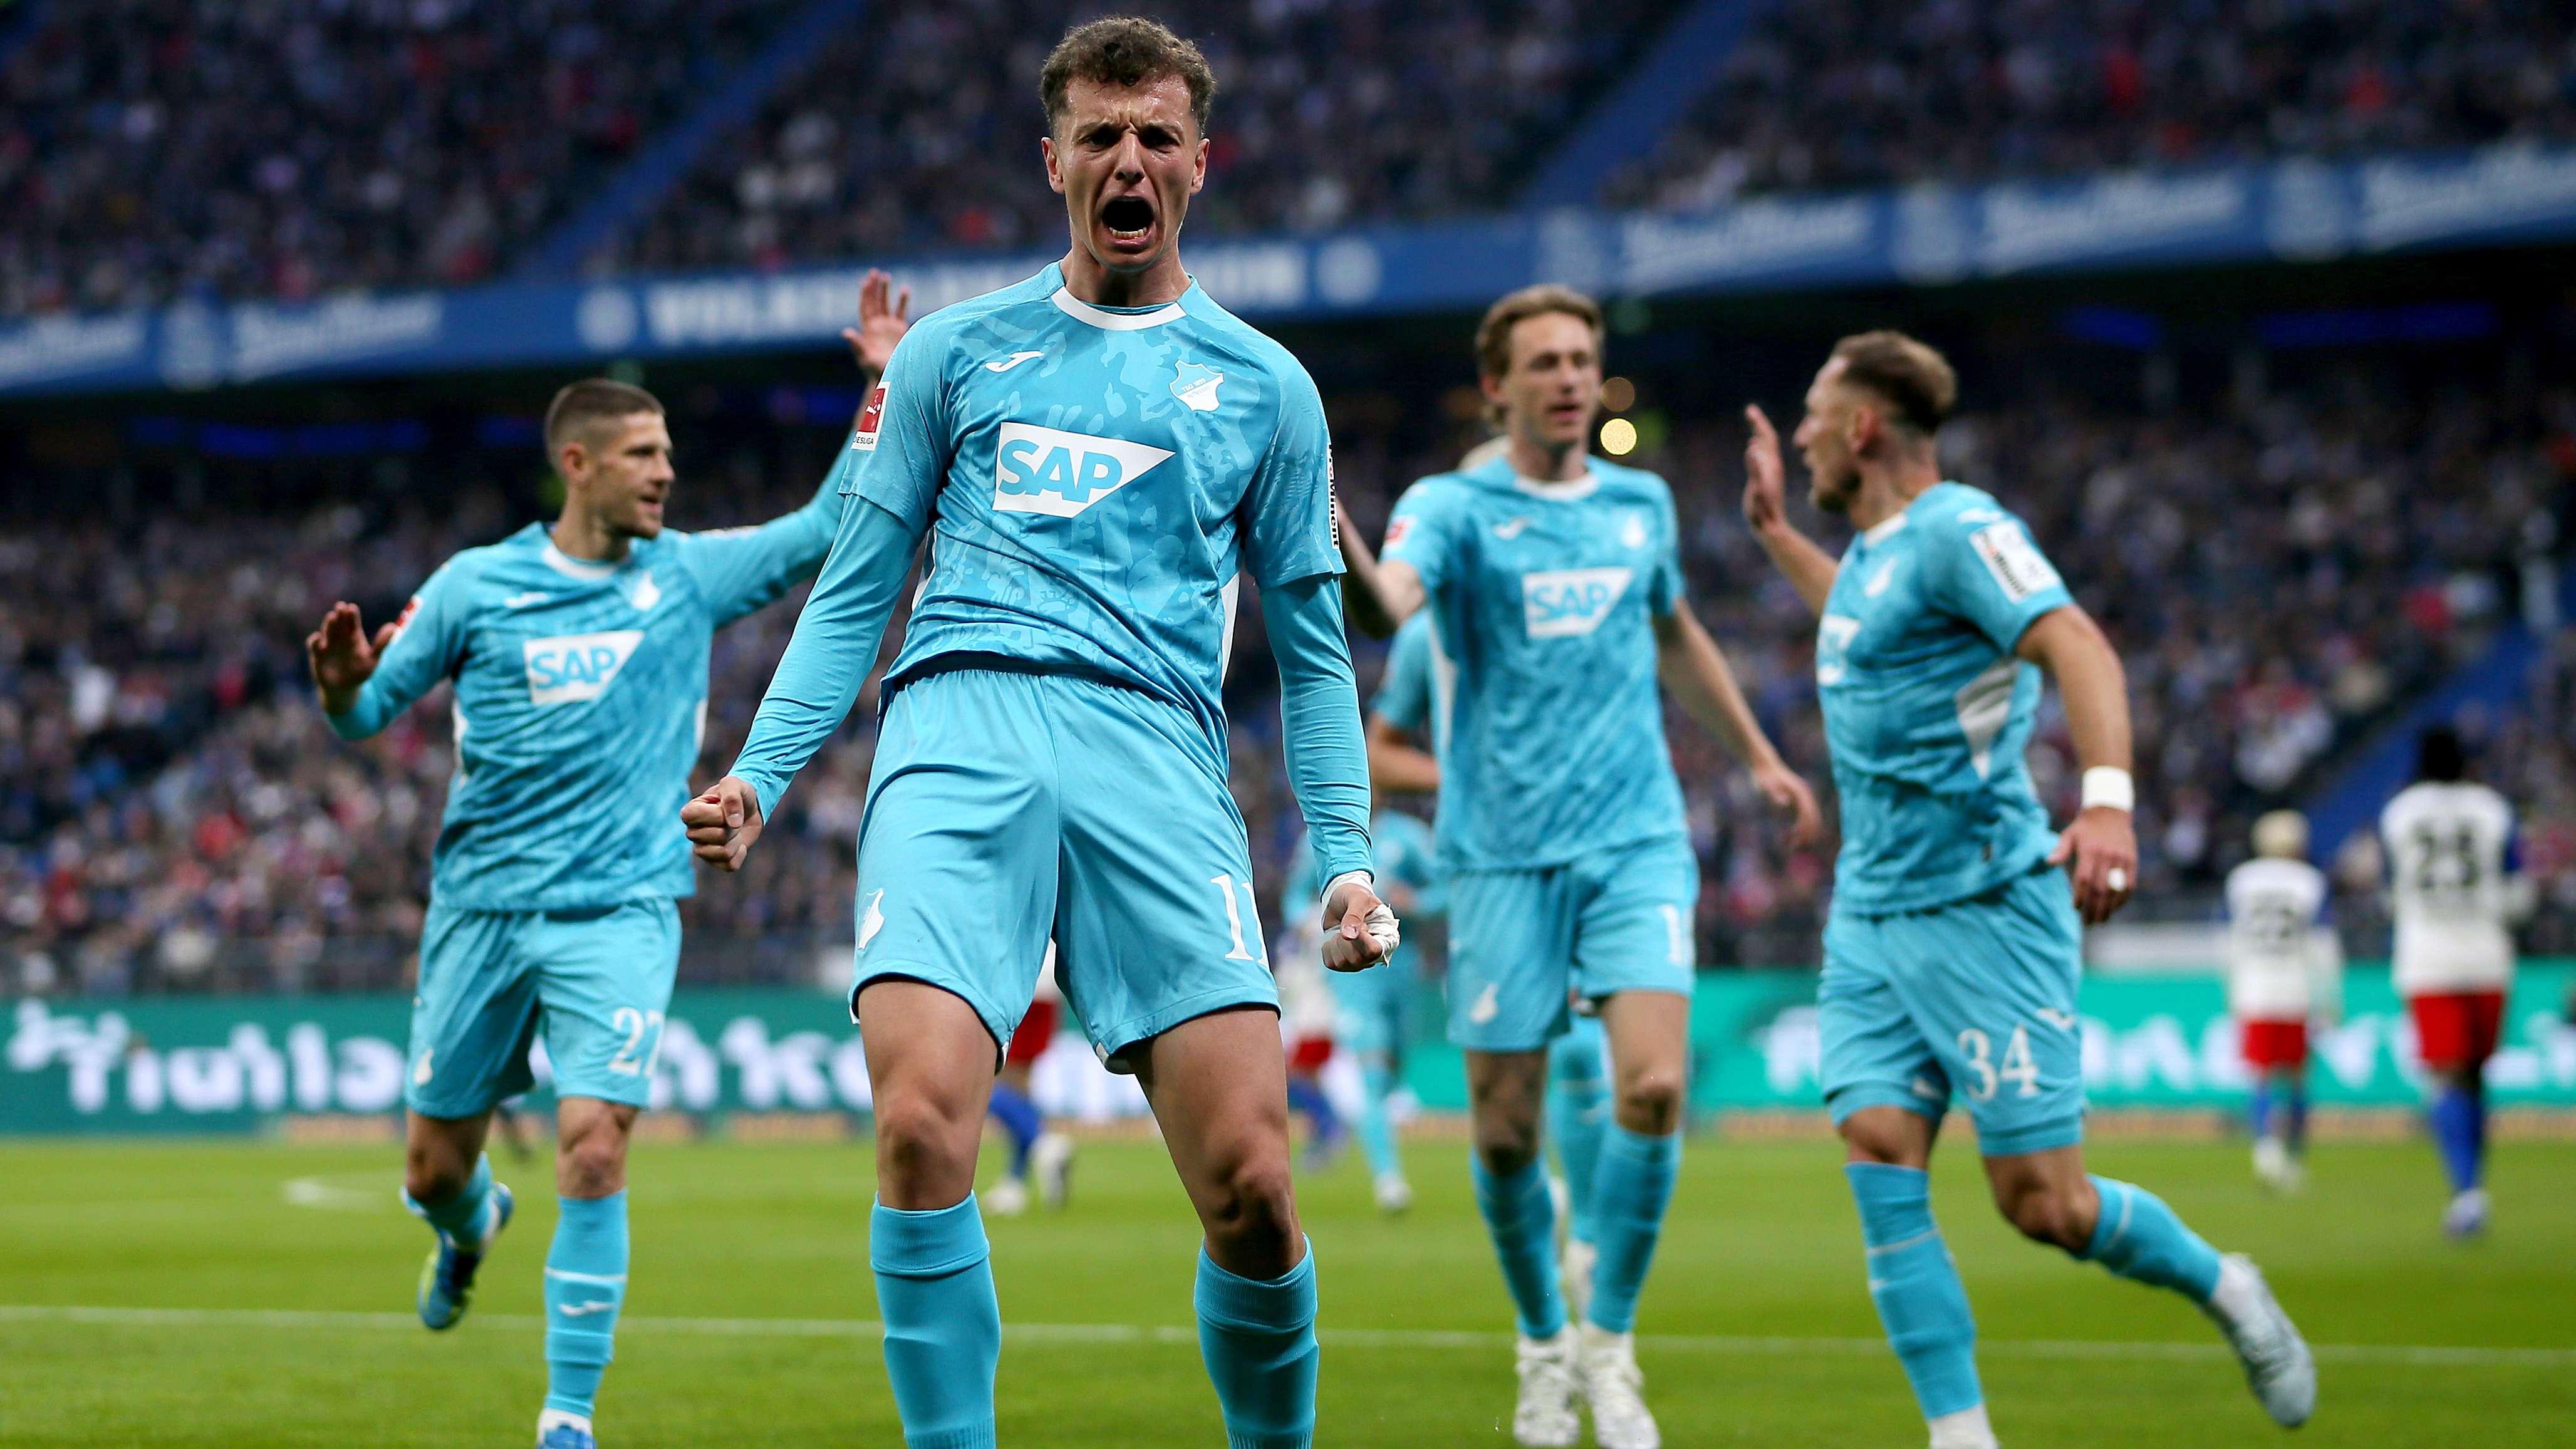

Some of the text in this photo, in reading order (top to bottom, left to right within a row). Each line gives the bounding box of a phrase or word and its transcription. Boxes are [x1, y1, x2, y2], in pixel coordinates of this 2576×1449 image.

[997, 439, 1123, 503] SAP
[1532, 583, 1609, 622] SAP
[530, 645, 617, 690] SAP
[609, 1006, 665, 1078] 27
[1956, 1025, 2040, 1100] 34
